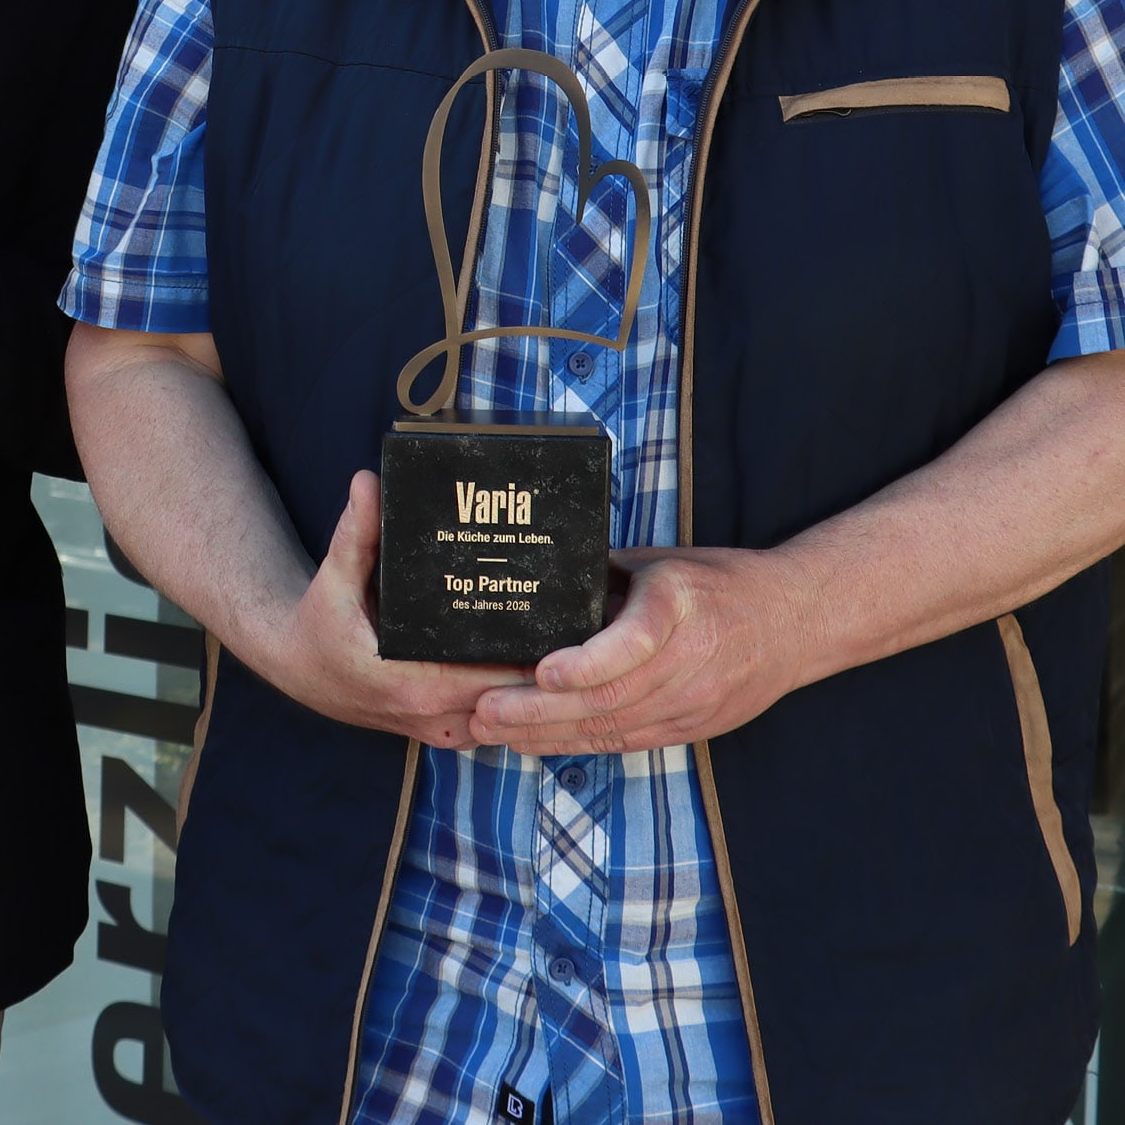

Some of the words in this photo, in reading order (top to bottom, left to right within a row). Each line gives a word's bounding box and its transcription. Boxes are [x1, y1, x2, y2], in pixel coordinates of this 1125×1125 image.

[456, 481, 532, 525] Varia
[437, 531, 454, 542] Die
[458, 531, 490, 543] Küche
[493, 533, 516, 543] zum
[519, 533, 554, 545] Leben.
[444, 575, 473, 594] Top
[478, 576, 540, 593] Partner
[452, 599, 469, 610] des
[472, 600, 503, 610] Jahres
[506, 601, 530, 611] 2026
